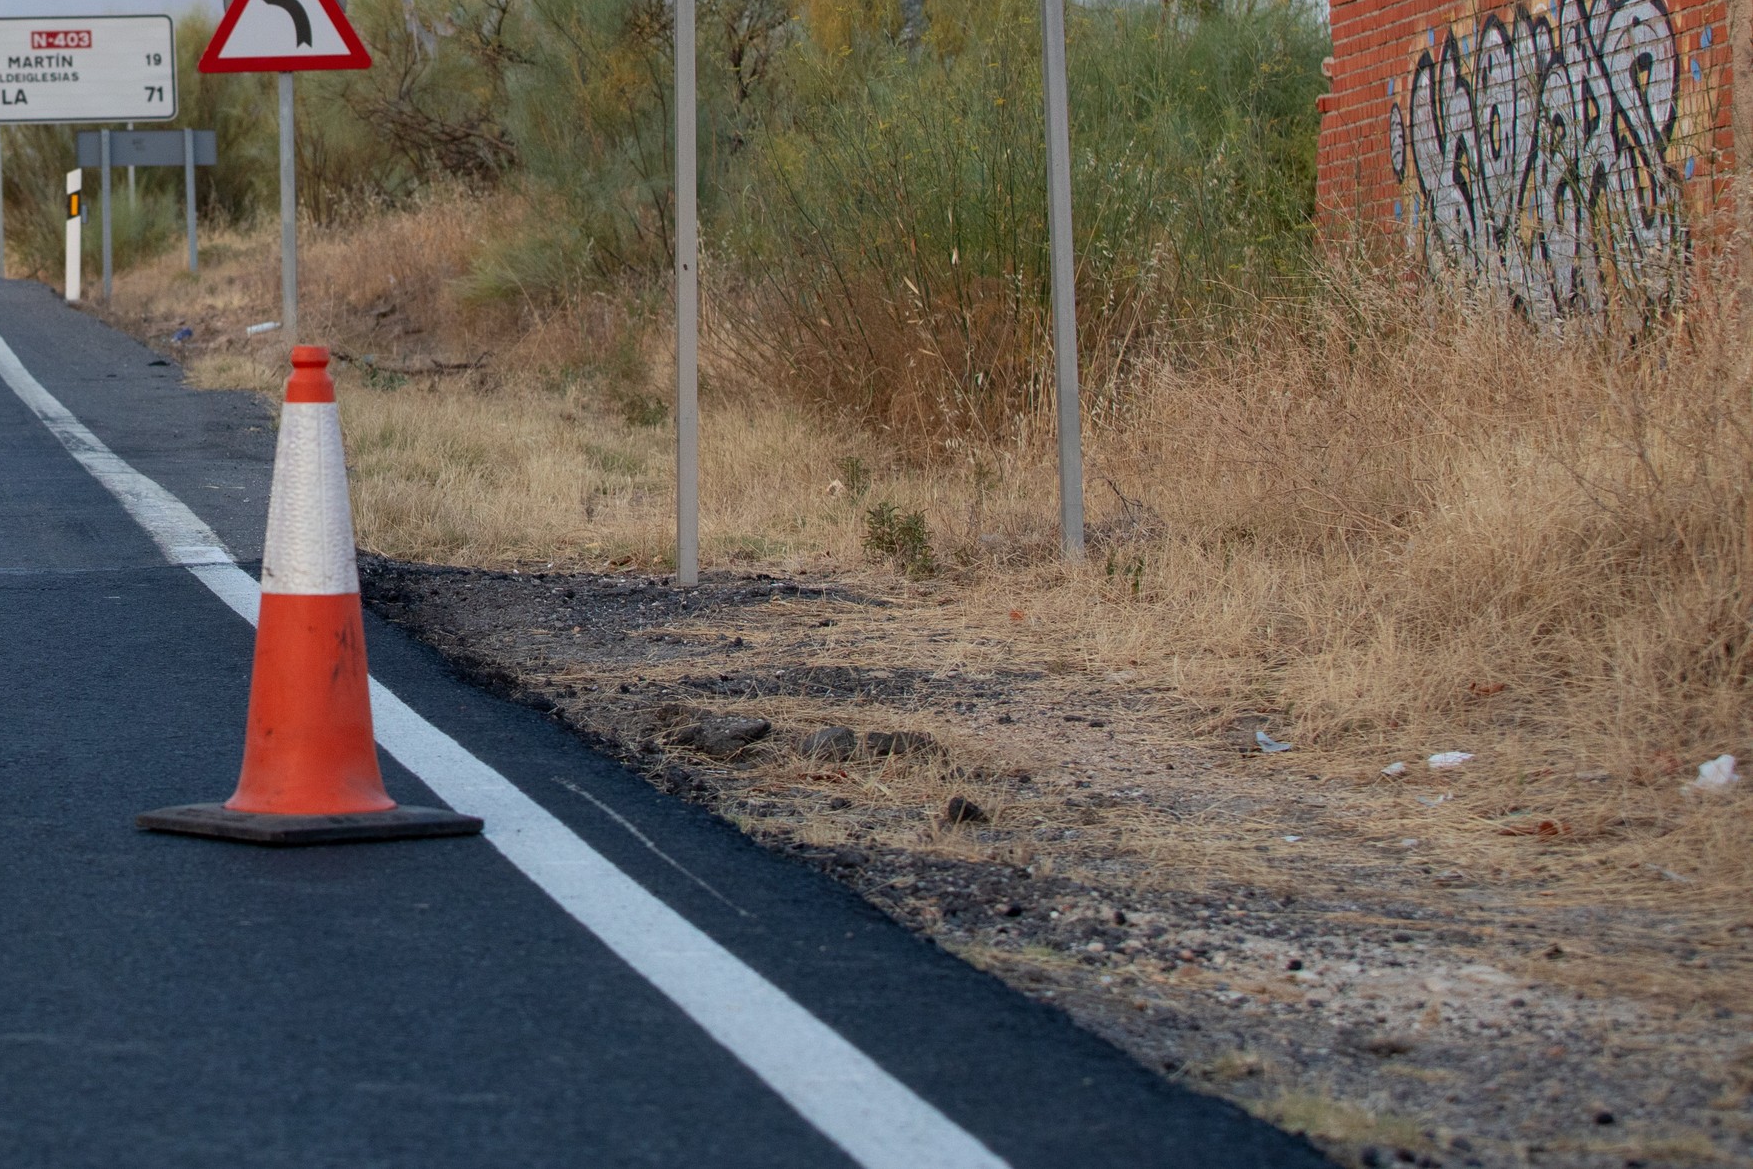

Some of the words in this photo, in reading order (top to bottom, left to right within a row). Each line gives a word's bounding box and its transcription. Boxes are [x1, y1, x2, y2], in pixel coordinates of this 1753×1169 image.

[32, 32, 90, 47] N-403
[8, 53, 73, 68] MARTÍN
[145, 53, 163, 66] 19
[144, 86, 164, 102] 71
